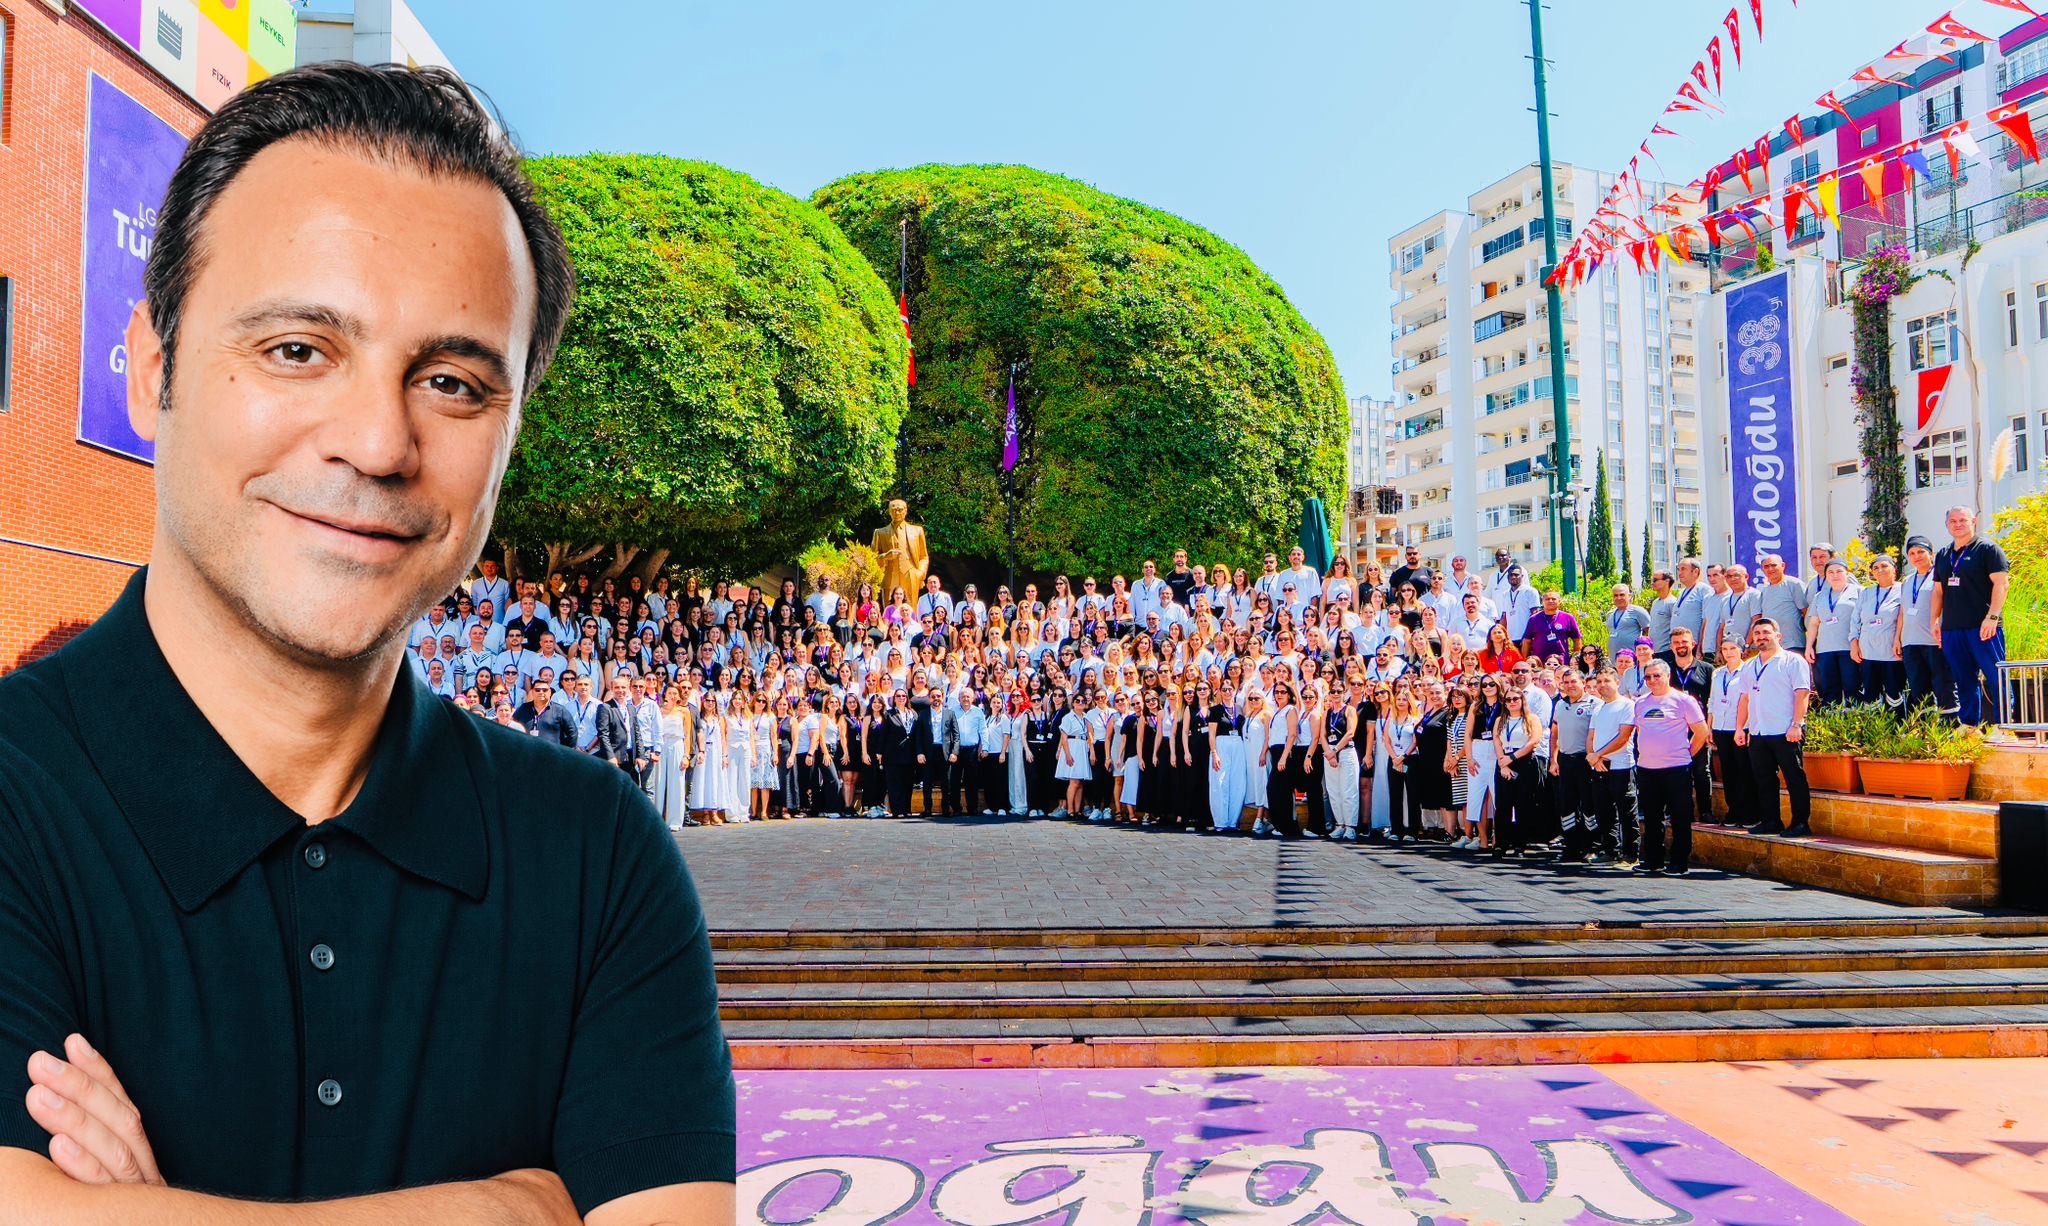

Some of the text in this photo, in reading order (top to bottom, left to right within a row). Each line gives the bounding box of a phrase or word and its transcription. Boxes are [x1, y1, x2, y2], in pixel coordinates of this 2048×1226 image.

[259, 16, 286, 47] HEYKEL
[139, 202, 156, 227] LG
[1738, 314, 1782, 375] 38
[1744, 394, 1785, 592] ndoğdu
[736, 1129, 1696, 1226] oğdu
